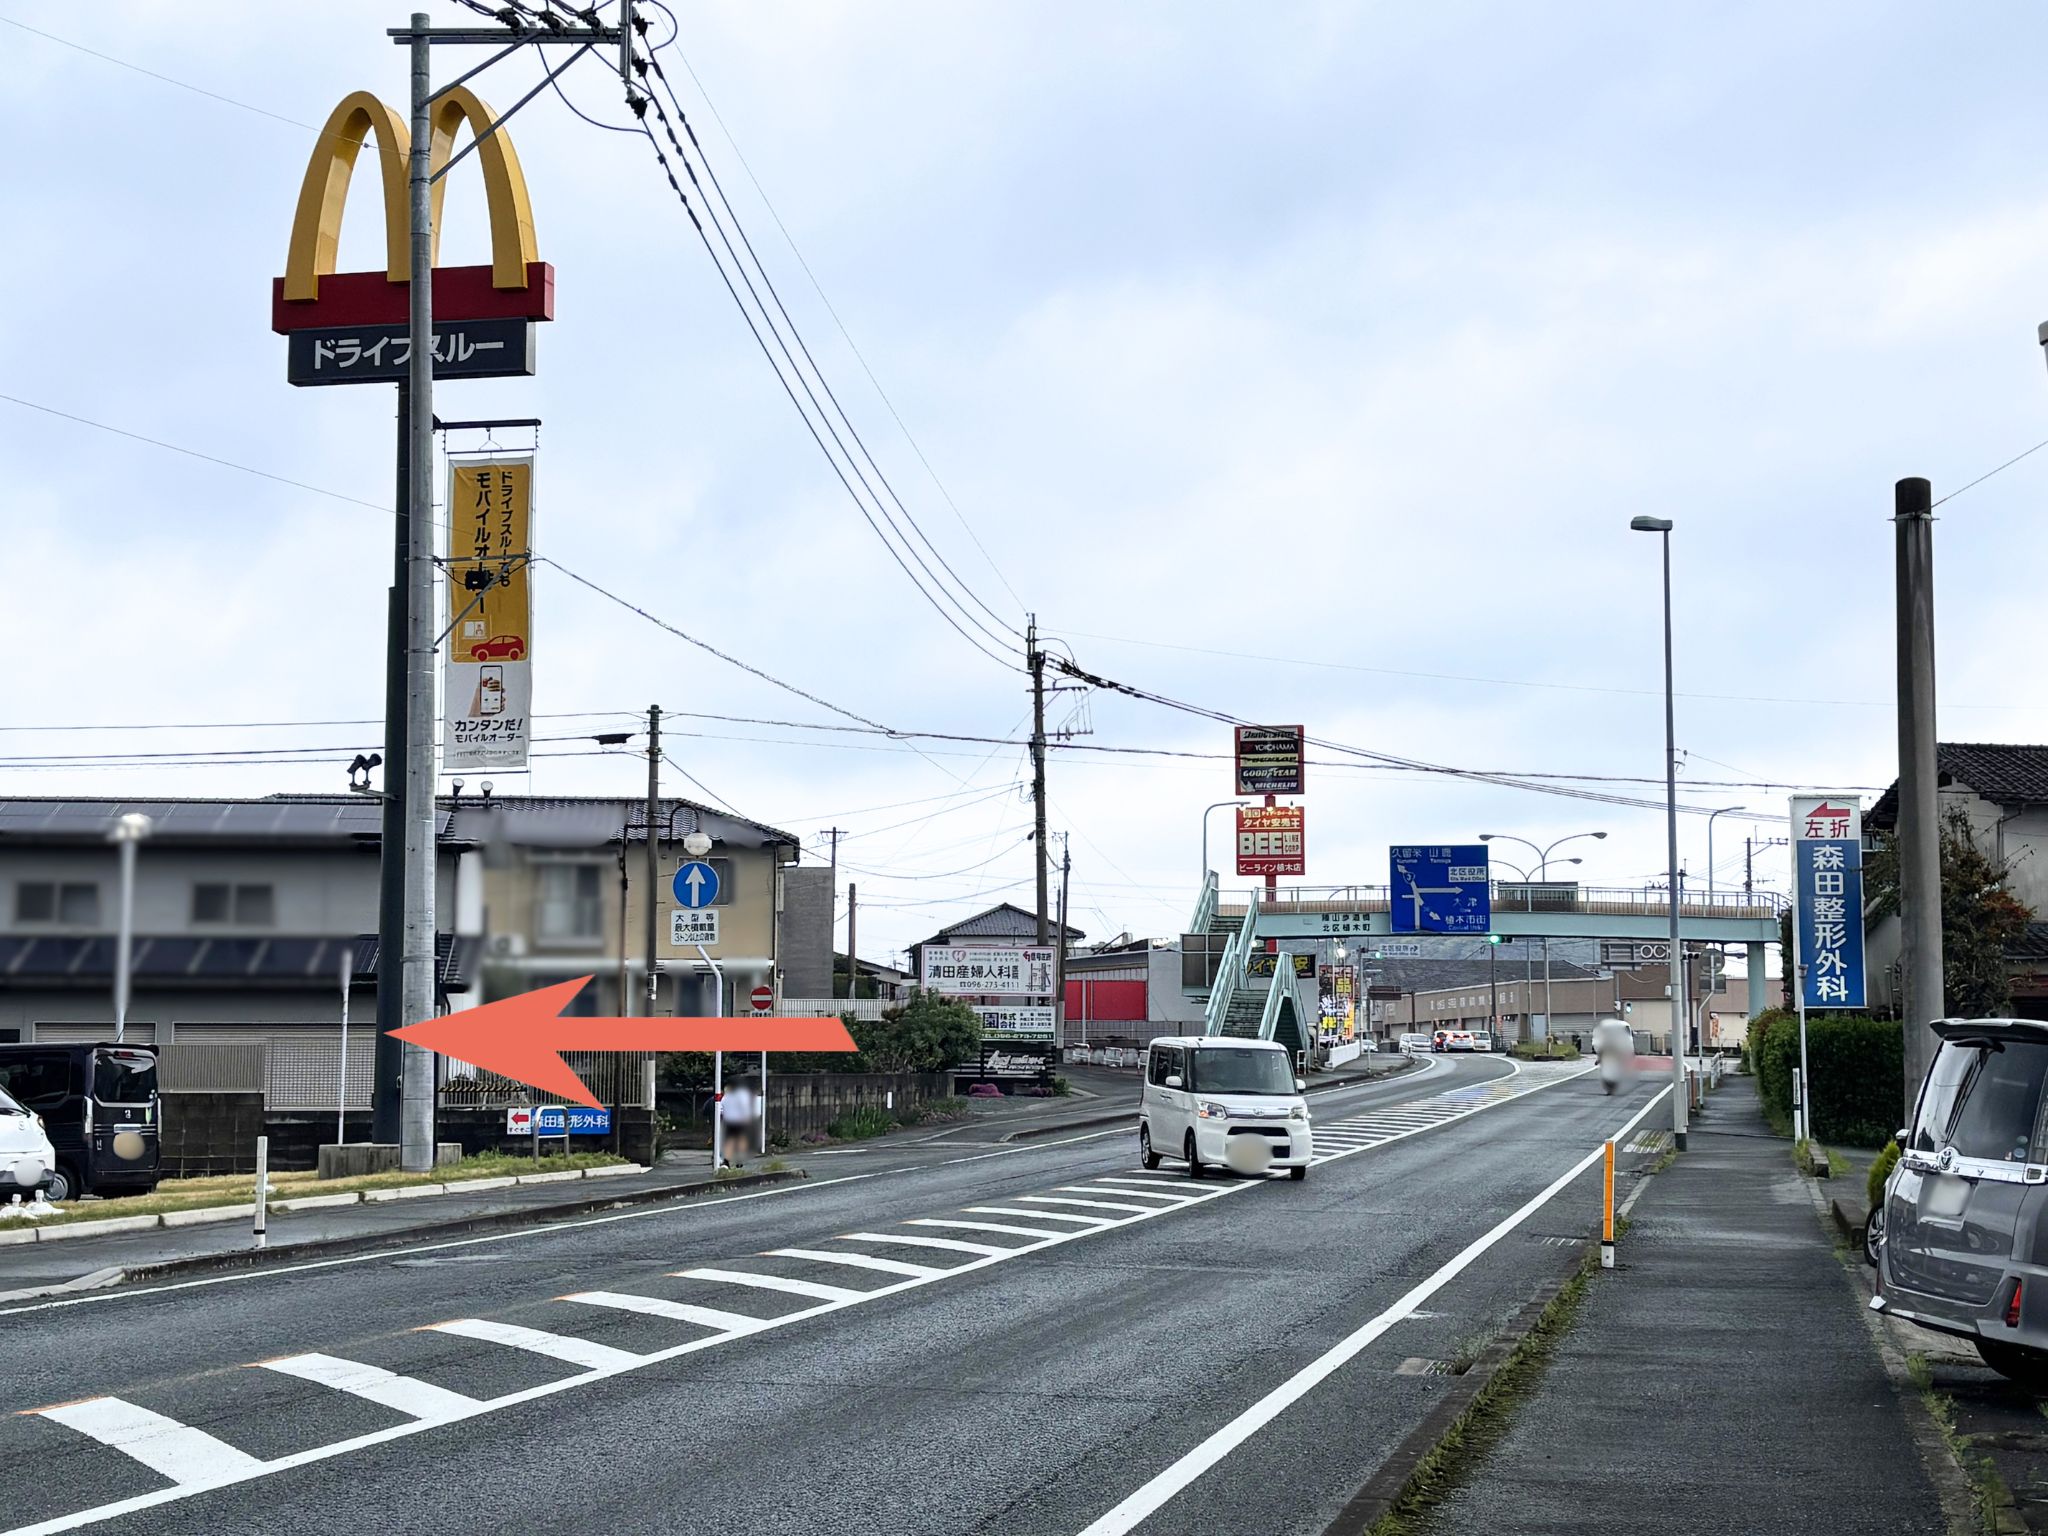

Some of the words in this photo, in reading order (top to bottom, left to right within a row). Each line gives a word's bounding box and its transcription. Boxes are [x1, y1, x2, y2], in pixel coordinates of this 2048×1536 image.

[474, 472, 491, 613] モバイルオーー
[454, 733, 524, 743] モバイルオーダー
[1805, 818, 1850, 838] 左折
[1239, 832, 1283, 855] BEE
[1391, 848, 1423, 858] 久留米
[1450, 868, 1485, 876] 北区役所
[1812, 844, 1848, 1002] 森田整形外科
